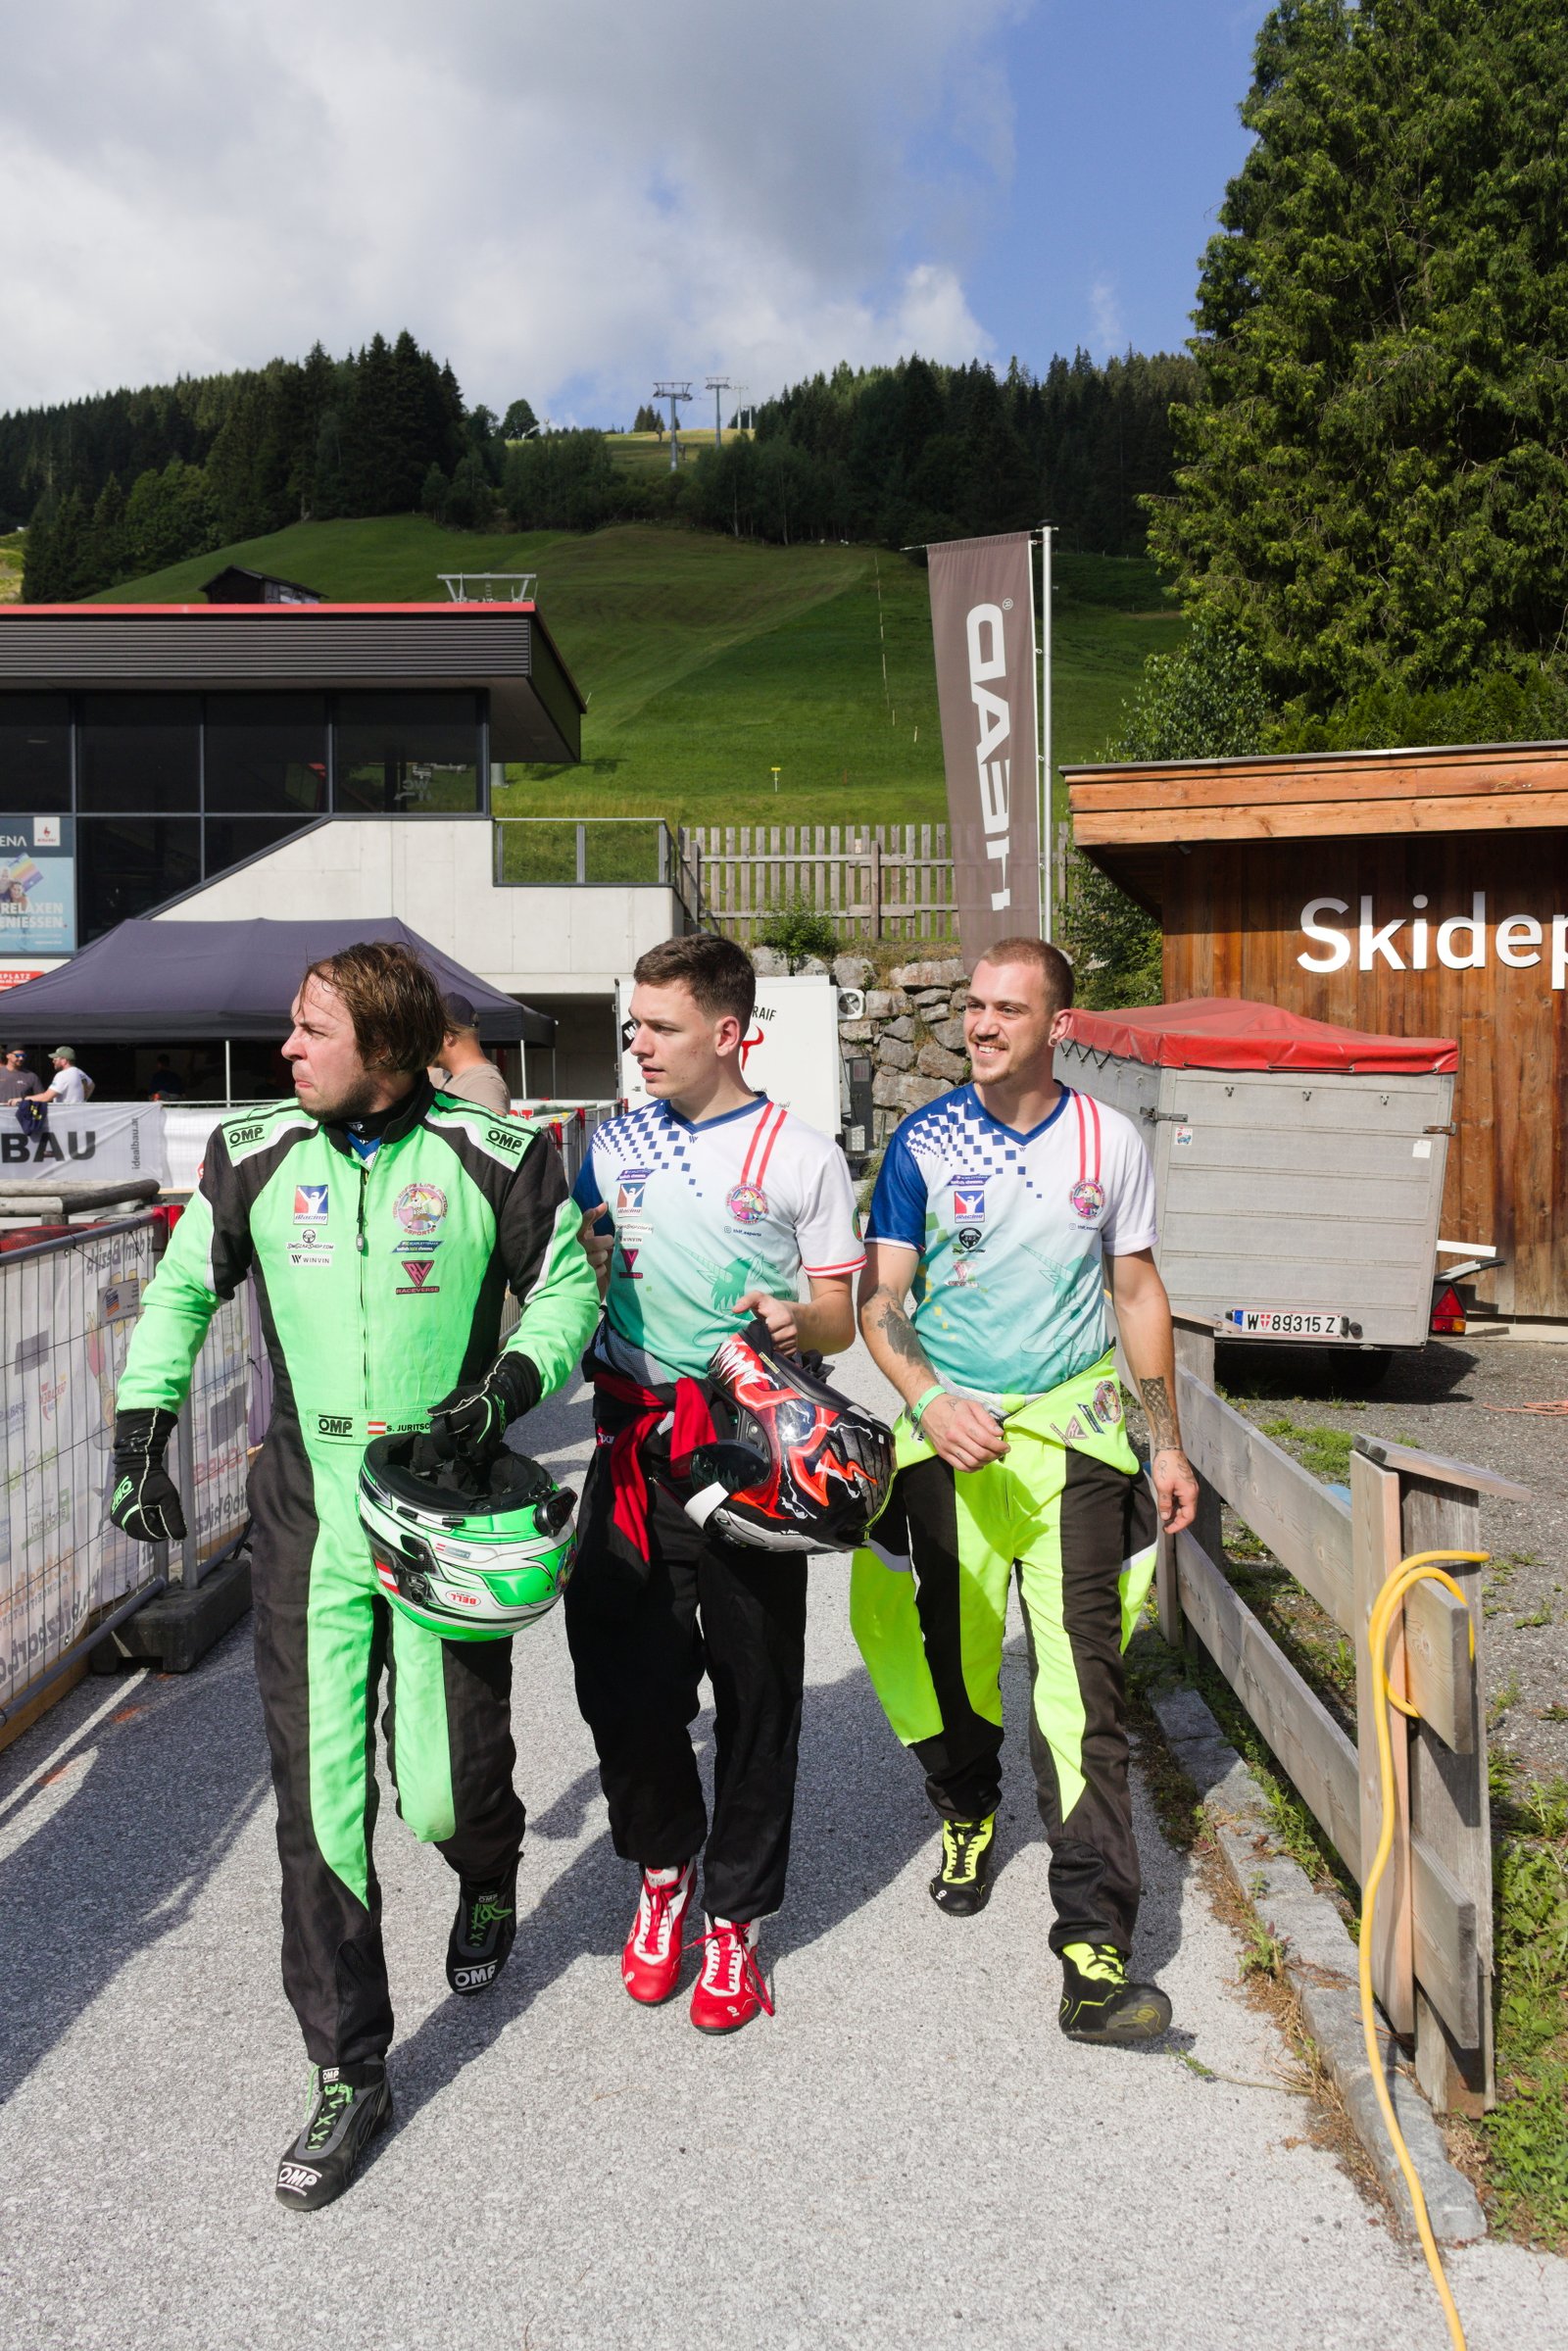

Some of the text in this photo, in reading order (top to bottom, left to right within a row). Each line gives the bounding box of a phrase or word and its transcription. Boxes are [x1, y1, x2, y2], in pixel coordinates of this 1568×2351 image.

[1, 903, 63, 914] RELAXEN
[228, 1127, 264, 1145] OMP
[487, 1129, 522, 1151] OMP
[1248, 1314, 1335, 1334] W 89315 Z
[318, 1418, 352, 1434] OMP
[386, 1422, 430, 1433] S. JURITSC
[451, 1592, 477, 1605] BELL
[455, 1964, 497, 1986] OMP
[322, 2070, 340, 2081] OMP
[278, 2167, 318, 2188] OMP
